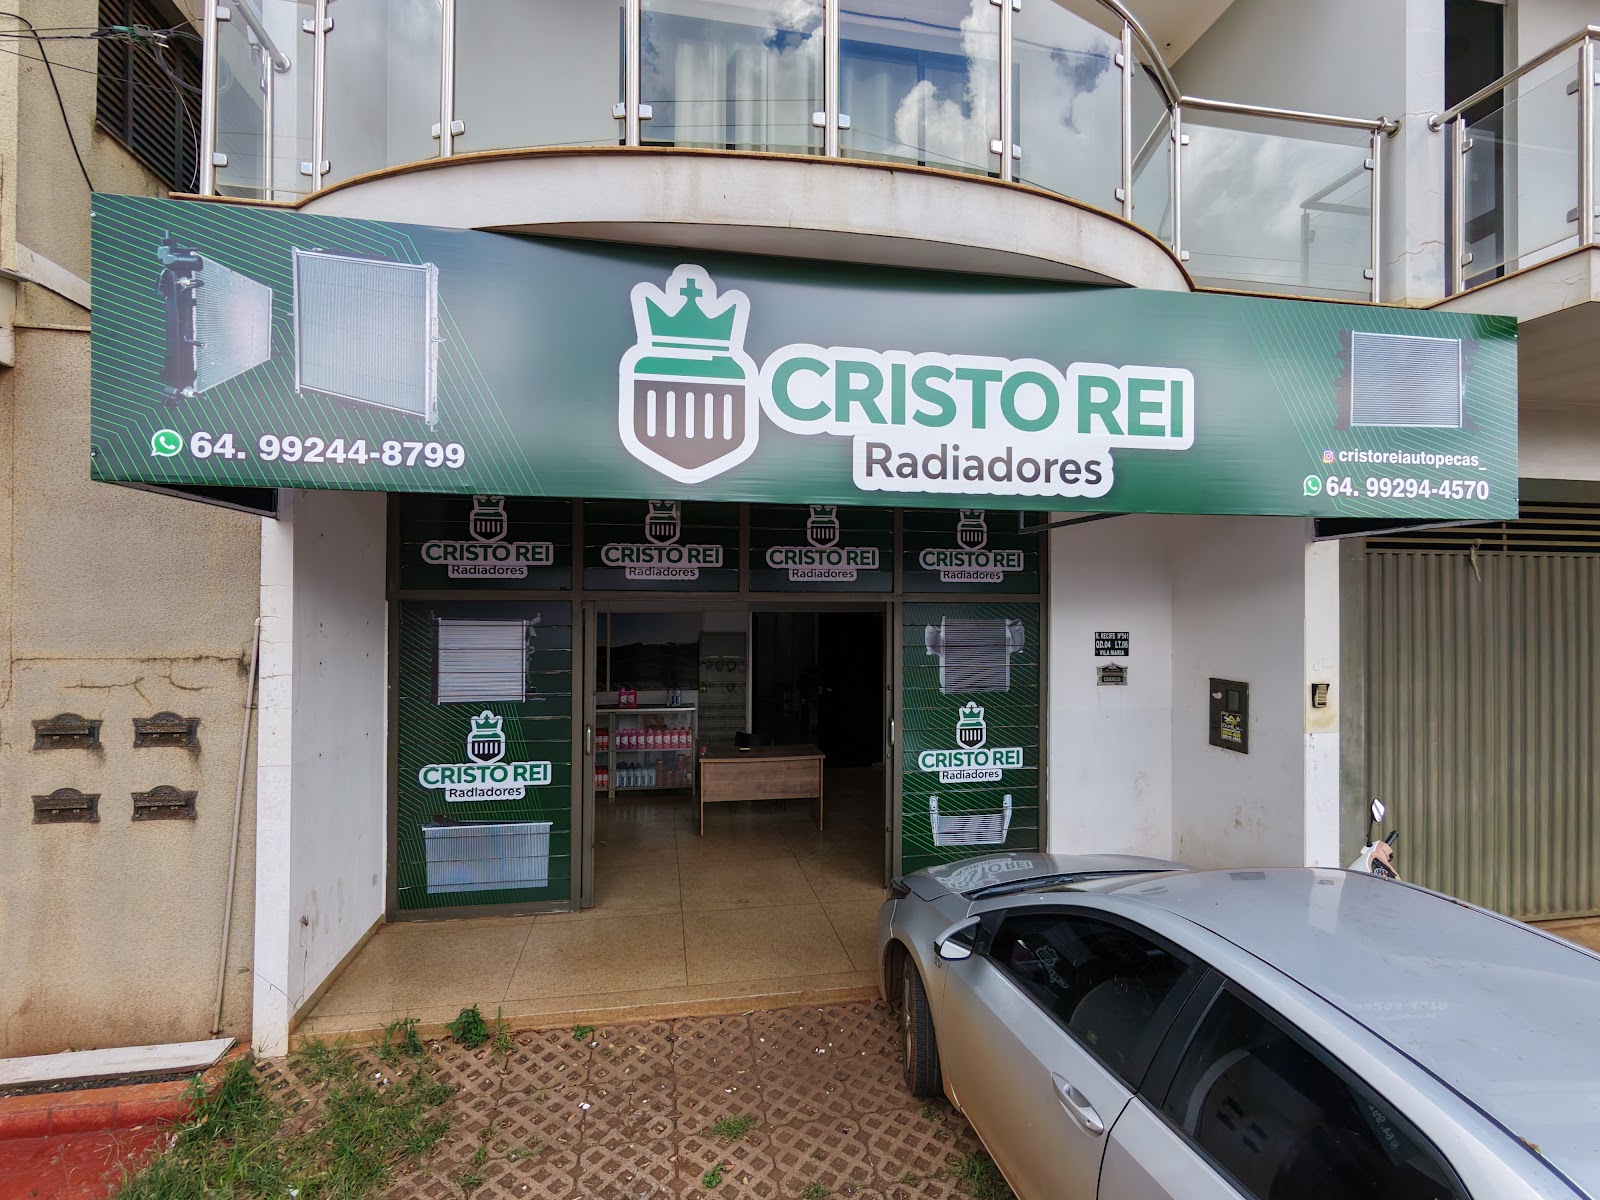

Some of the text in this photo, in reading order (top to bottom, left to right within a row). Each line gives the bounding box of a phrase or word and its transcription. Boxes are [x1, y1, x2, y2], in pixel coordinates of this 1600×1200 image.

[771, 356, 1184, 438] CRISTO REI
[190, 432, 465, 469] 64. 99244-8799
[1338, 448, 1487, 471] cristoreiautopecas_
[865, 441, 1102, 485] Radiadores
[1326, 475, 1490, 500] 64. 99294-4570
[425, 543, 550, 562] CRISTO REI
[604, 546, 720, 564] CRISTO REI
[769, 549, 876, 566] CRISTO REI
[922, 551, 1021, 568] CRISTO REI
[451, 564, 524, 576] Radiadores
[629, 566, 696, 578] Radiadores
[791, 568, 854, 579] Radiadores
[943, 570, 1001, 580] Radiadores
[922, 750, 1020, 768] CRISTO REI
[423, 764, 548, 784] CRISTO REI
[942, 770, 999, 780] Radiadores
[450, 787, 521, 798] Radiadores
